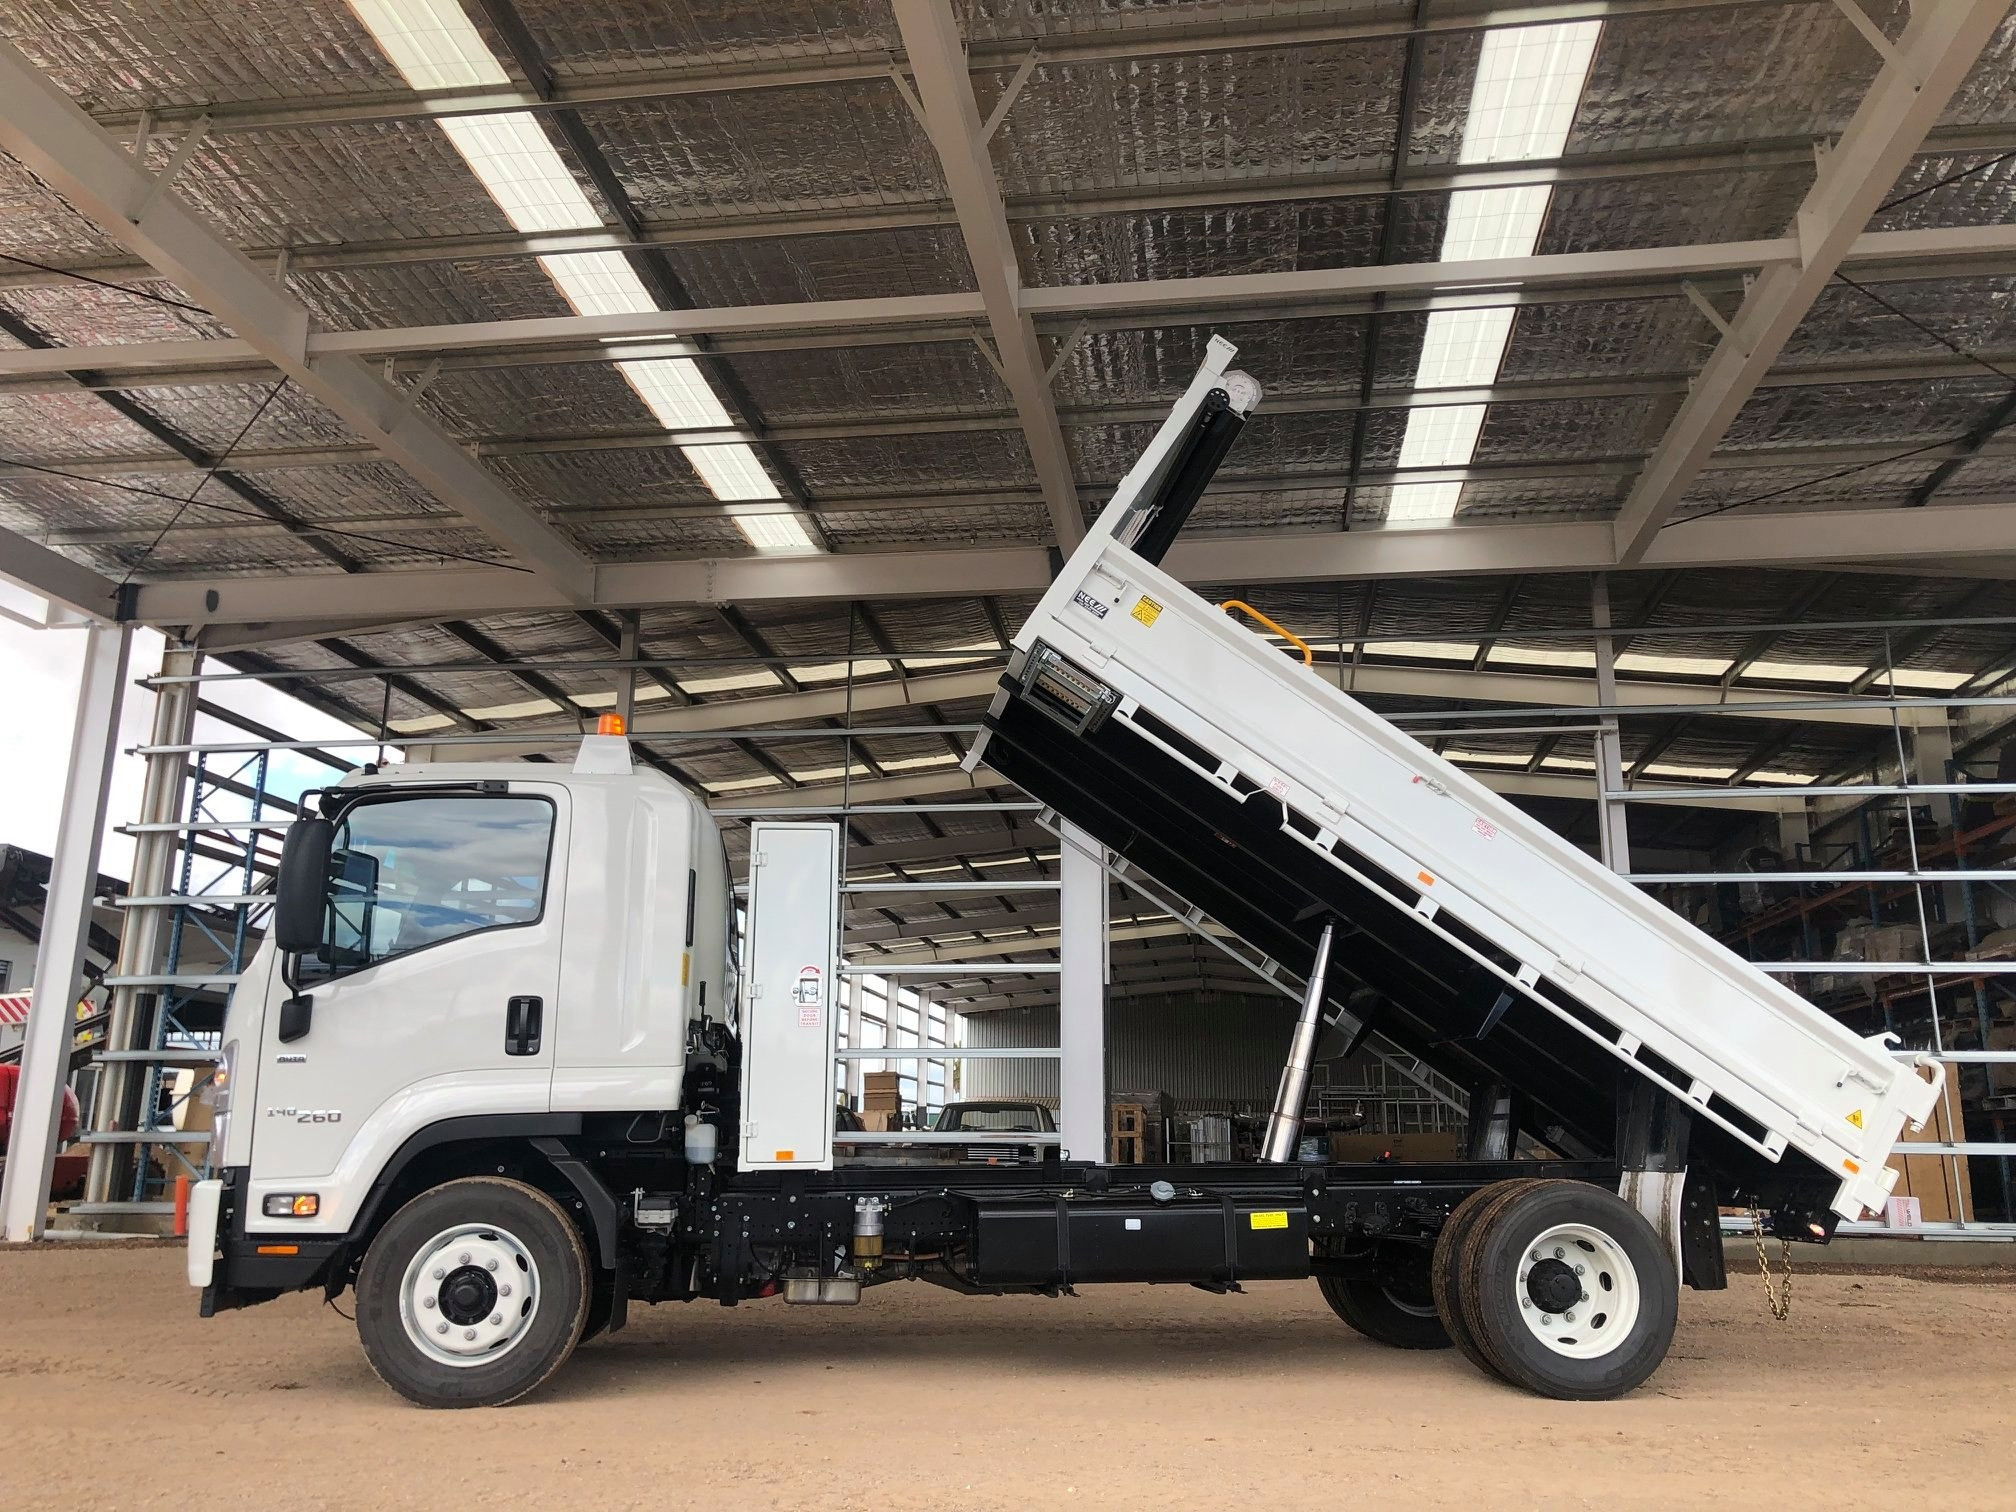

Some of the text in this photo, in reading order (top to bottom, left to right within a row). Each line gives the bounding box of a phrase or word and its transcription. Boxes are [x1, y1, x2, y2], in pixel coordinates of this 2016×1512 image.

[1142, 595, 1162, 612] CAUTION
[267, 1107, 342, 1123] 140 260
